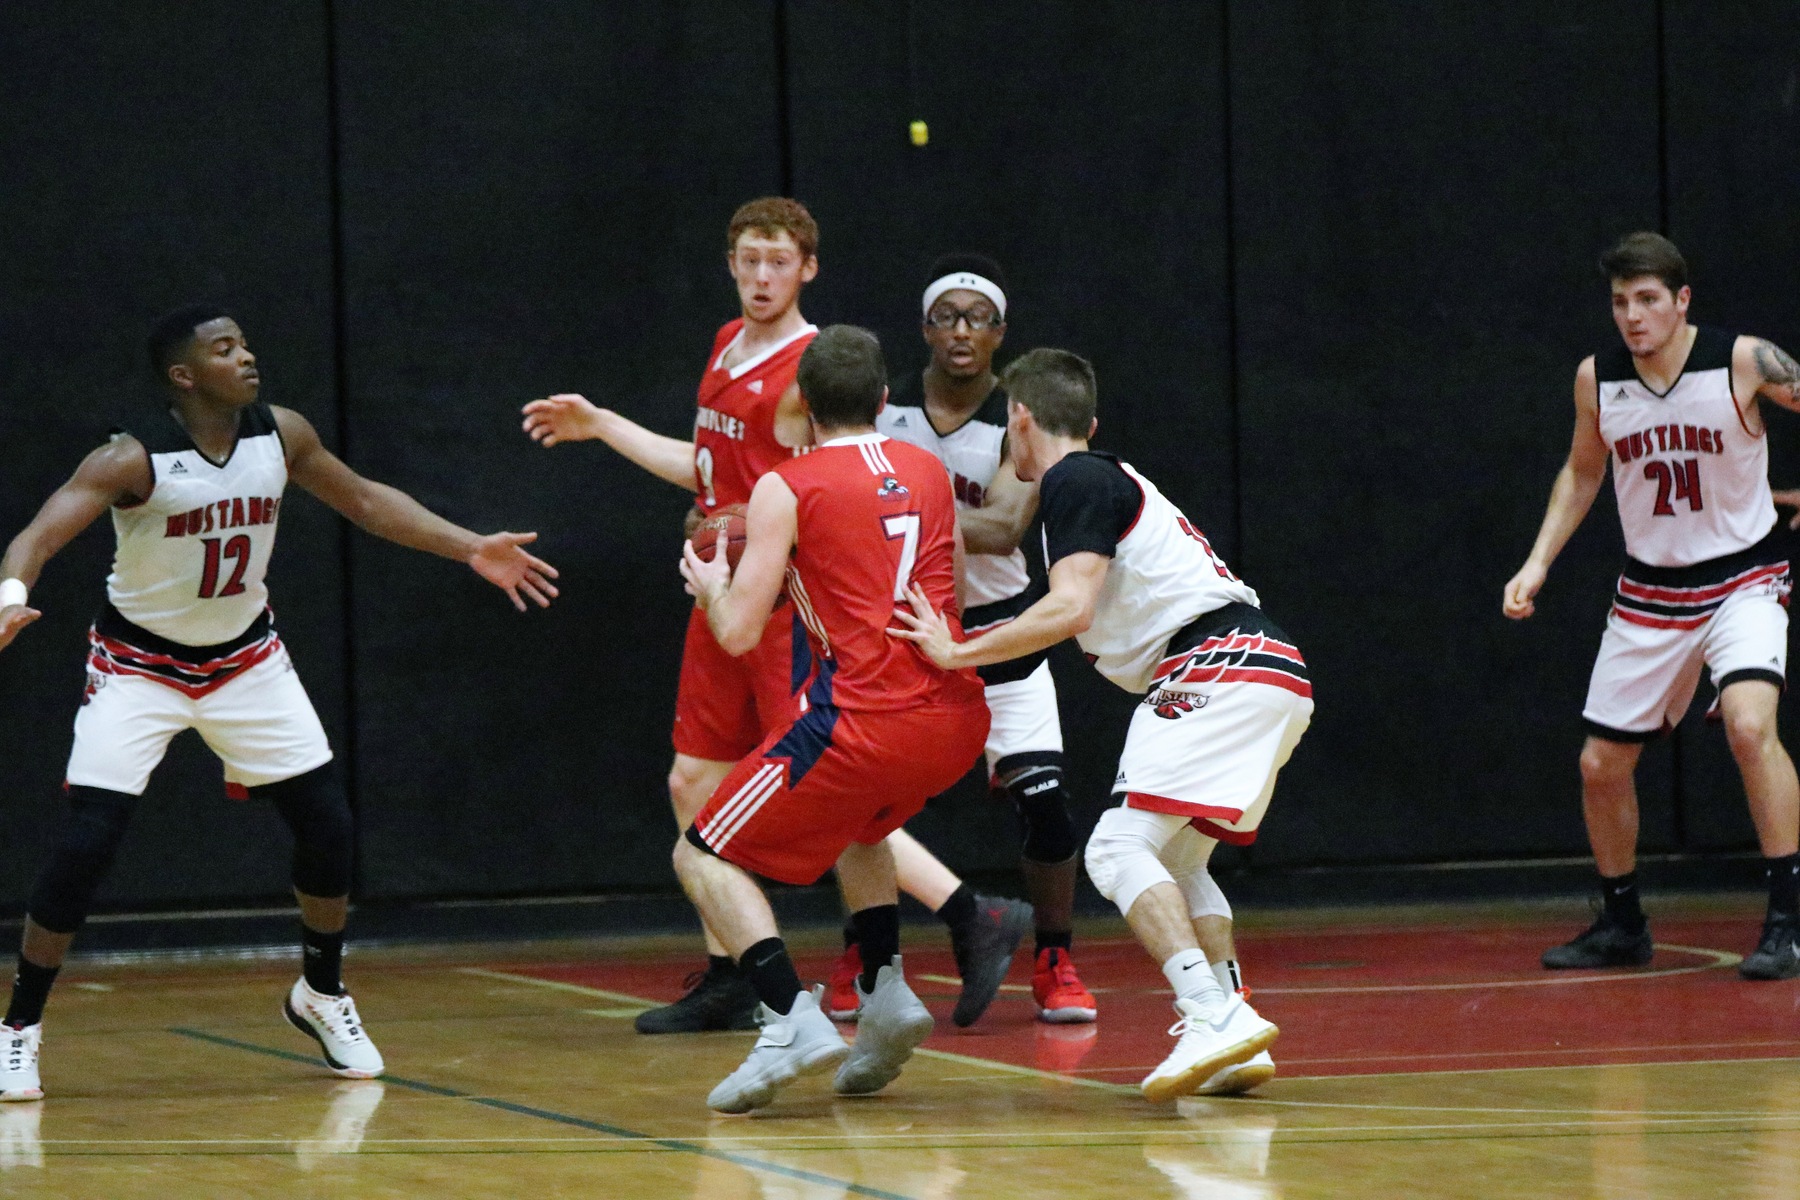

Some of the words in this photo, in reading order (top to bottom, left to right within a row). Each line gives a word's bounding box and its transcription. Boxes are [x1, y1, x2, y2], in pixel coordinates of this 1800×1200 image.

[1614, 423, 1724, 464] MUSTANGS
[1643, 456, 1704, 517] 24
[197, 533, 252, 599] 12
[879, 511, 922, 605] 7
